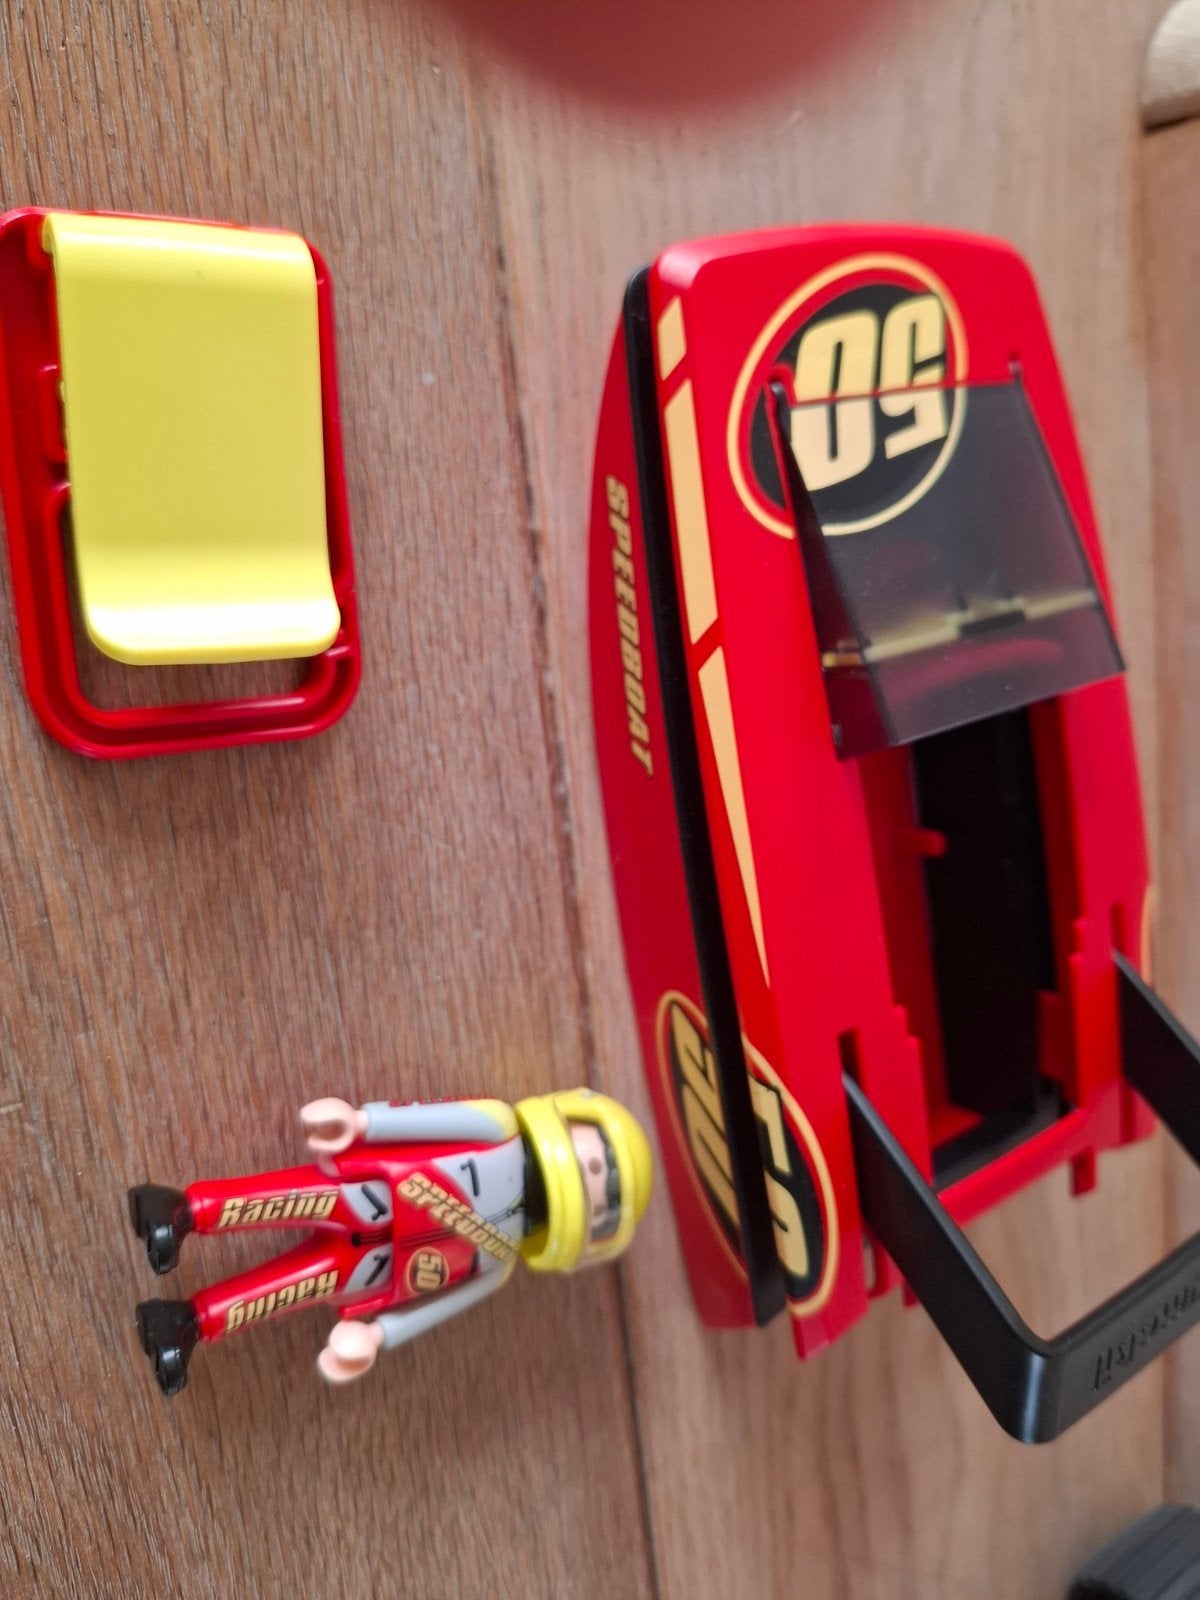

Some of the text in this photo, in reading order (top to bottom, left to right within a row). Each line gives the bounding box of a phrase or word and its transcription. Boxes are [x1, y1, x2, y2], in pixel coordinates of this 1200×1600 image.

[789, 293, 949, 491] 50
[606, 472, 653, 777] SPEEDBOAT
[670, 999, 809, 1277] 50
[218, 1188, 339, 1228] Racing
[416, 1252, 443, 1289] 50
[225, 1270, 339, 1334] Racing
